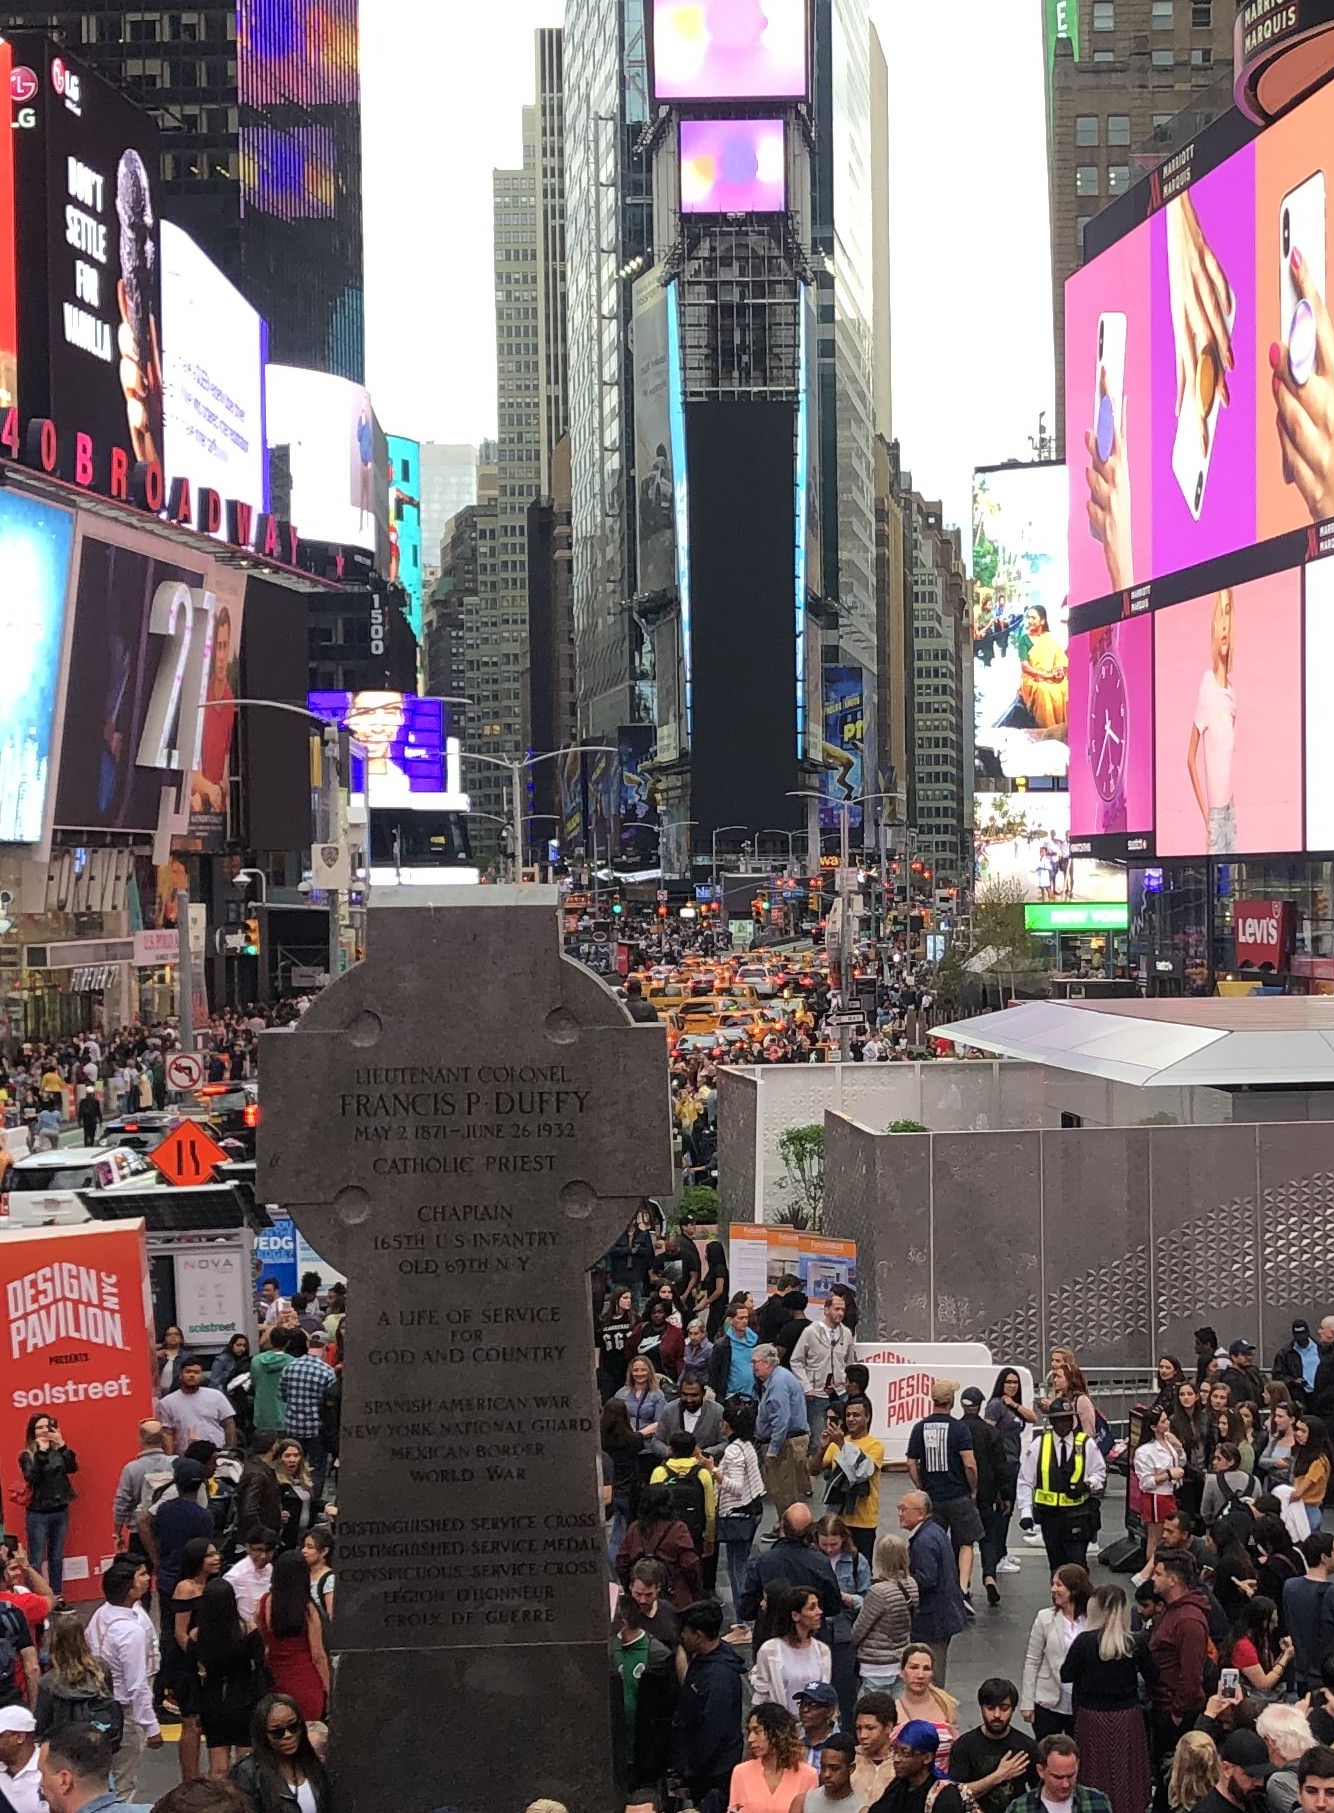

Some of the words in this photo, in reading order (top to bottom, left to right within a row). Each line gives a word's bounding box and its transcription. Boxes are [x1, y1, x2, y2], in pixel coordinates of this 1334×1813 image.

[1244, 6, 1296, 54] MARQUIS
[1162, 143, 1195, 178] MARRIOTT
[1162, 166, 1191, 199] MARQUIS
[65, 203, 107, 263] SETTLE
[75, 258, 101, 309] FOR
[75, 431, 300, 567] BROADWAY
[370, 593, 384, 655] 1500
[355, 1066, 472, 1085] LIEUTENANT
[477, 1064, 573, 1084] COLONEL
[340, 1092, 457, 1118] FRANCIS
[495, 1090, 591, 1116] DUFFY
[355, 1125, 391, 1142] MAY
[396, 1125, 408, 1140] 2
[414, 1124, 447, 1140] 1871
[463, 1123, 505, 1140] JUNE
[511, 1123, 531, 1139] 26
[536, 1122, 576, 1139] 1932
[372, 1157, 474, 1175] CATHOLIC
[486, 1155, 557, 1172] PRIEST
[417, 1205, 514, 1222] CHAPLAIN
[373, 1233, 425, 1250] 165TH
[473, 1231, 560, 1249] INFANTRY
[183, 1258, 233, 1270] NOVA
[398, 1259, 439, 1275] OLD
[444, 1257, 489, 1275] 69TH
[6, 1262, 99, 1320] DESIGN
[100, 1271, 121, 1310] NYC
[377, 1311, 391, 1326] A
[399, 1309, 440, 1326] LIFE
[446, 1308, 474, 1325] OF
[481, 1306, 562, 1324] SERVICE
[10, 1301, 124, 1359] PAVILION
[189, 1321, 236, 1334] solstreet
[450, 1329, 483, 1344] FOR
[368, 1349, 416, 1366] GOD
[422, 1348, 465, 1365] AND
[471, 1345, 567, 1363] COUNTRY
[12, 1374, 133, 1408] solstreet
[364, 1399, 433, 1415] SPANISH
[438, 1397, 528, 1412] AMERICAN
[534, 1395, 572, 1410] WAR
[342, 1424, 382, 1440] NEW
[386, 1422, 433, 1438] YORK
[440, 1420, 526, 1436] NATIONAL
[531, 1418, 593, 1433] GUARD
[390, 1446, 470, 1461] MEXICAN
[476, 1443, 546, 1458] BORDER
[409, 1468, 475, 1484] WORLD
[486, 1465, 527, 1482] WAR
[338, 1517, 465, 1536] DISTINGUISHED
[471, 1515, 537, 1531] SERVICE
[543, 1513, 598, 1529] CROSS
[338, 1541, 465, 1559] DISTINGUISHED
[471, 1539, 537, 1555] SERVICE
[543, 1537, 601, 1553] MEDAL
[338, 1565, 464, 1583] CONSPICUOUS
[471, 1563, 537, 1578] SERVICE
[543, 1560, 598, 1576] CROSS
[383, 1612, 442, 1627] CROIX
[451, 1611, 475, 1626] DE
[485, 1608, 556, 1625] GUERRE
